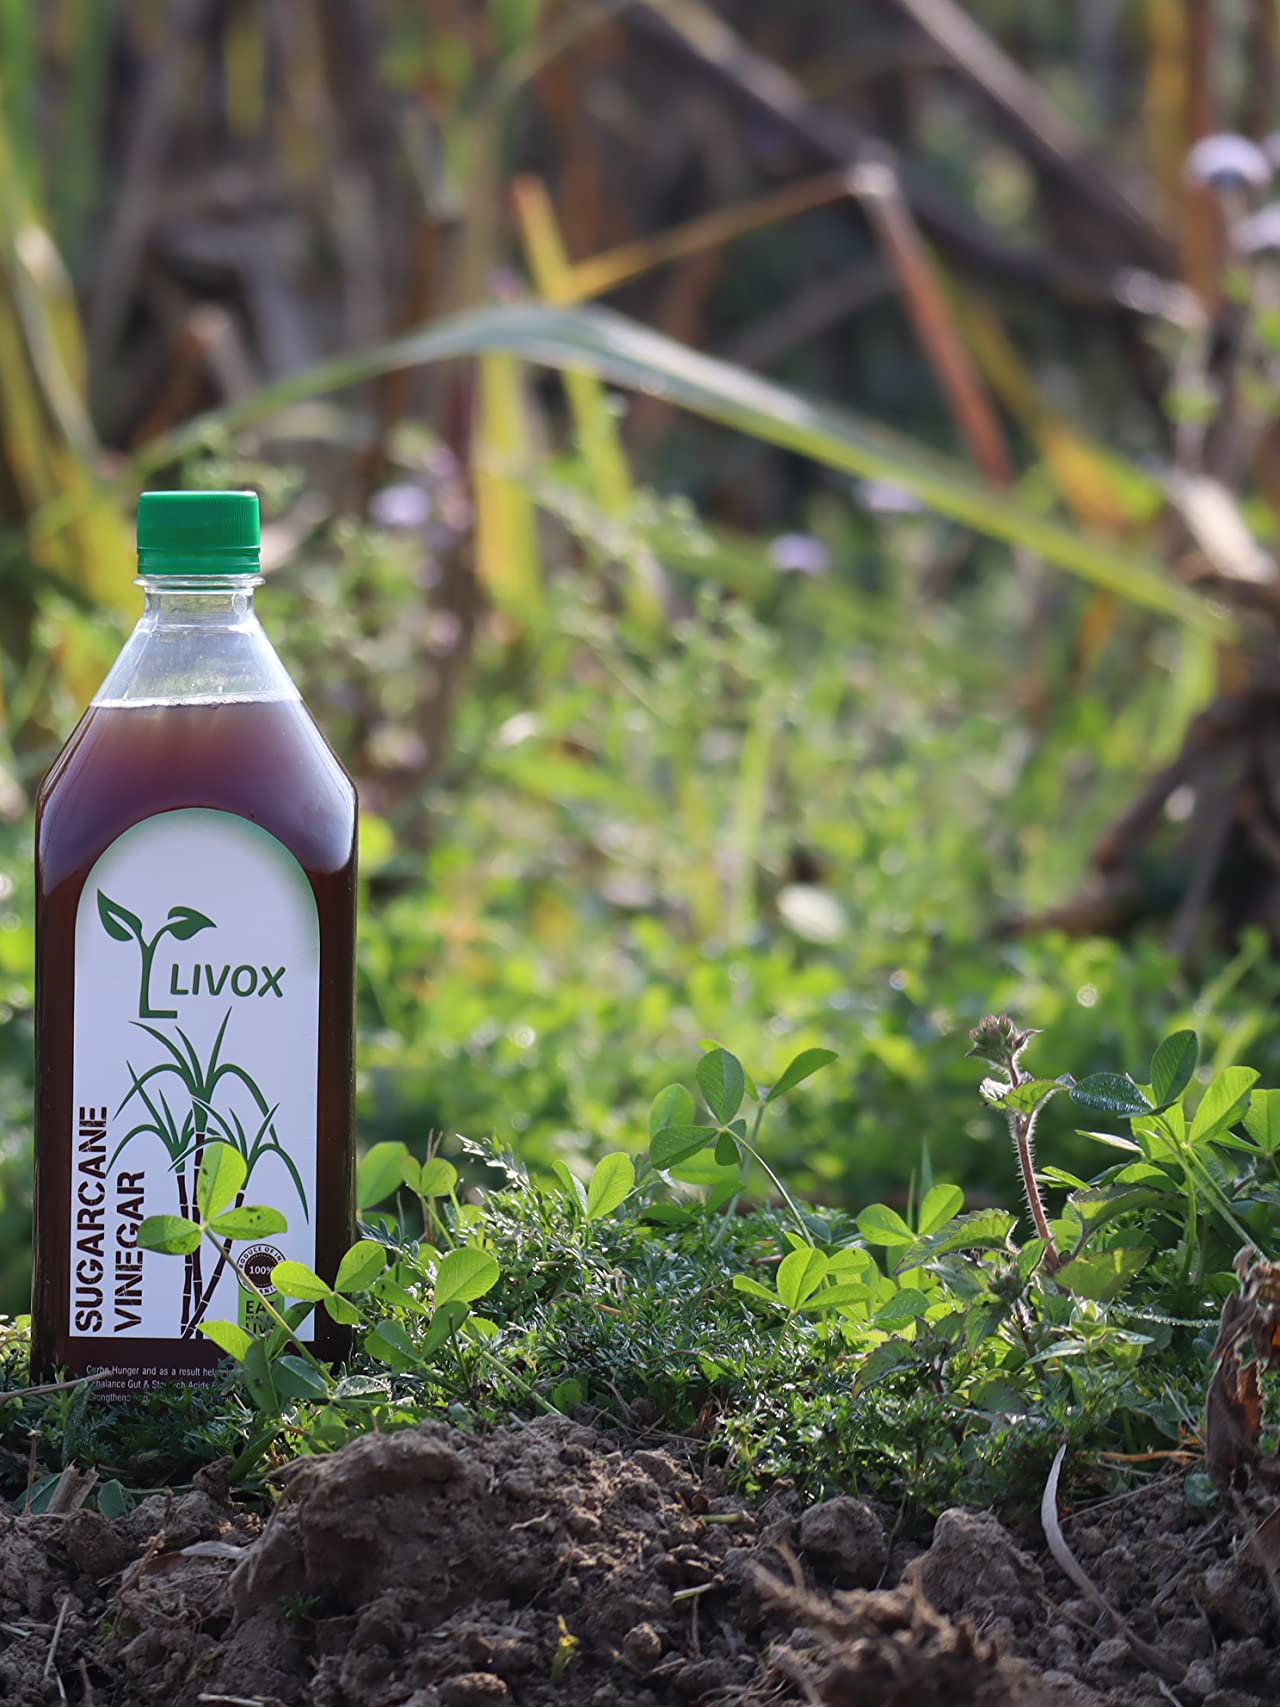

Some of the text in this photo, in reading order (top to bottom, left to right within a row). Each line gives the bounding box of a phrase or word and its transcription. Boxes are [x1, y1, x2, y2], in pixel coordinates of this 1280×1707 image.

[170, 963, 286, 998] LIVOX
[75, 1106, 107, 1333] SUGARCANE
[114, 1171, 145, 1333] VINEGAR
[111, 1365, 140, 1377] Hunger
[142, 1366, 157, 1375] and
[159, 1368, 169, 1376] as
[171, 1368, 177, 1376] a
[179, 1367, 201, 1377] result
[127, 1379, 141, 1389] Gut
